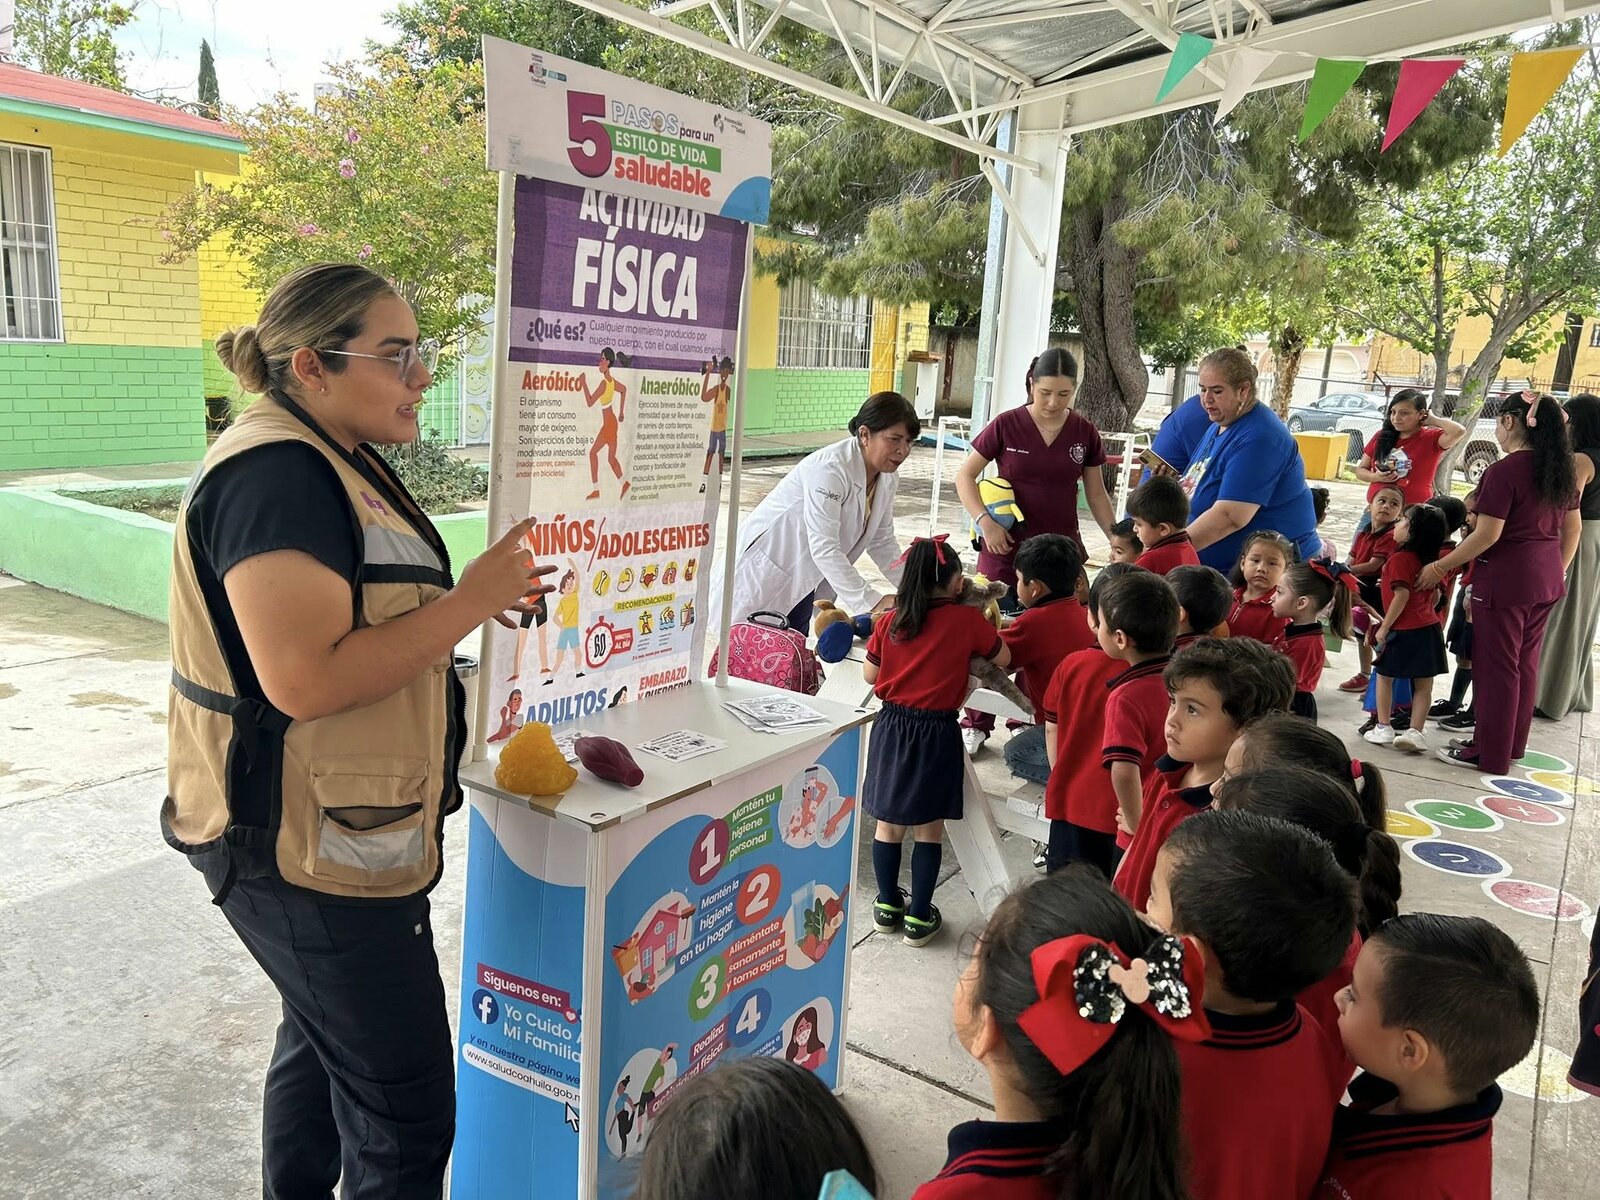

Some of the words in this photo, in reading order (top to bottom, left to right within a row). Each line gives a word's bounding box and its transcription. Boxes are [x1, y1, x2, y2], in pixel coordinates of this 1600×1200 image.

[612, 100, 679, 135] PASOS
[566, 90, 612, 178] 5
[615, 131, 658, 153] ESTILO
[661, 141, 676, 158] DE
[679, 145, 707, 165] VIDA
[680, 126, 701, 139] para
[703, 132, 715, 142] un
[614, 155, 712, 197] saludable
[579, 188, 706, 242] ACTIVIDAD
[571, 226, 697, 320] FÍSICA
[527, 317, 561, 342] ¿Qué
[564, 321, 586, 341] es?
[589, 320, 625, 333] Cualquier
[626, 324, 663, 337] movimiento
[665, 329, 696, 340] producido
[697, 332, 707, 342] por
[589, 336, 616, 346] nuestro
[645, 341, 656, 350] con
[658, 342, 664, 351] el
[665, 342, 679, 352] cual
[680, 345, 703, 353] usamos
[521, 370, 583, 392] Aeróbico
[640, 376, 700, 396] Anaeróbico
[519, 410, 536, 419] tiene
[547, 412, 576, 420] consumo
[520, 396, 527, 406] El
[528, 398, 562, 408] organismo
[518, 424, 539, 434] mayor
[540, 423, 550, 432] de
[518, 435, 532, 445] Son
[533, 437, 565, 446] ejercicios
[566, 436, 575, 444] de
[576, 436, 589, 446] baja
[517, 449, 552, 457] moderada
[617, 594, 673, 610] RECOMENDACIONES
[593, 633, 606, 658] 60
[639, 665, 688, 690] EMBARAZO
[526, 688, 608, 724] ADULTOS
[732, 798, 765, 823] Mantén
[766, 792, 776, 806] tu
[731, 816, 763, 842] higiene
[700, 828, 721, 878] 1
[729, 832, 767, 862] personal
[701, 885, 732, 909] Mantén
[733, 879, 740, 893] la
[745, 872, 770, 917] 2
[700, 902, 733, 931] higiene
[904, 924, 916, 932] FILA
[679, 952, 693, 966] en
[694, 940, 706, 956] tu
[707, 918, 734, 948] hogar
[729, 920, 779, 956] Aliméntate
[728, 938, 781, 973] sanamente
[696, 963, 719, 1009] 3
[725, 980, 732, 992] y
[733, 968, 759, 987] toma
[760, 953, 784, 977] agua
[483, 971, 540, 1000] Síguenos
[541, 993, 562, 1007] en:
[504, 1003, 522, 1022] Yo
[526, 1013, 572, 1041] Cuido
[735, 995, 761, 1035] 4
[503, 1022, 521, 1041] Mi
[693, 1022, 725, 1057] Realiza
[470, 1033, 476, 1044] y
[477, 1038, 488, 1049] en
[490, 1043, 526, 1065] nuestra
[527, 1060, 563, 1078] página
[700, 1042, 724, 1069] física
